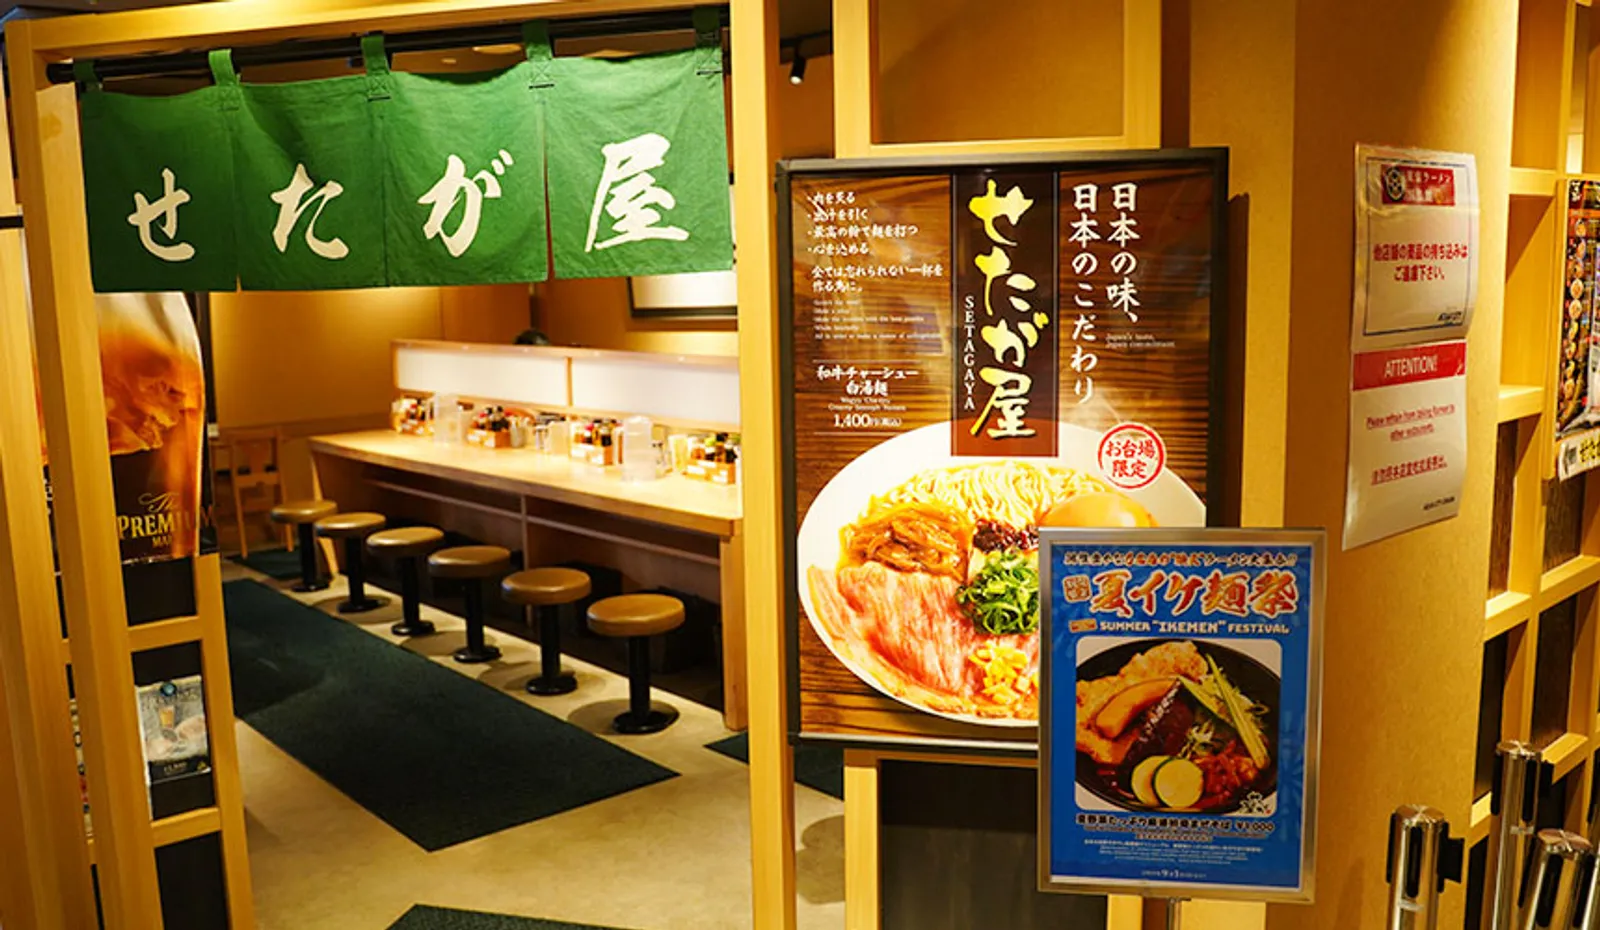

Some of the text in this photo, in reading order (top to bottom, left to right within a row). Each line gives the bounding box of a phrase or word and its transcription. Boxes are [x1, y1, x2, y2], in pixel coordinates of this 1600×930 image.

[127, 132, 689, 262] せたが屋
[1106, 182, 1141, 323] 日本の味、
[968, 178, 1050, 438] せたが屋
[1068, 183, 1100, 405] 日本のこだわり
[817, 365, 919, 380] 和牛チャーシュー
[964, 295, 975, 410] SETAGAYA
[1384, 355, 1438, 378] ATTENTION!
[1106, 439, 1155, 459] お台場
[1112, 460, 1147, 479] 限定
[1089, 569, 1299, 618] 夏イケ麺祭
[1100, 621, 1151, 632] SUMMER
[1228, 623, 1290, 634] FESTIVAL
